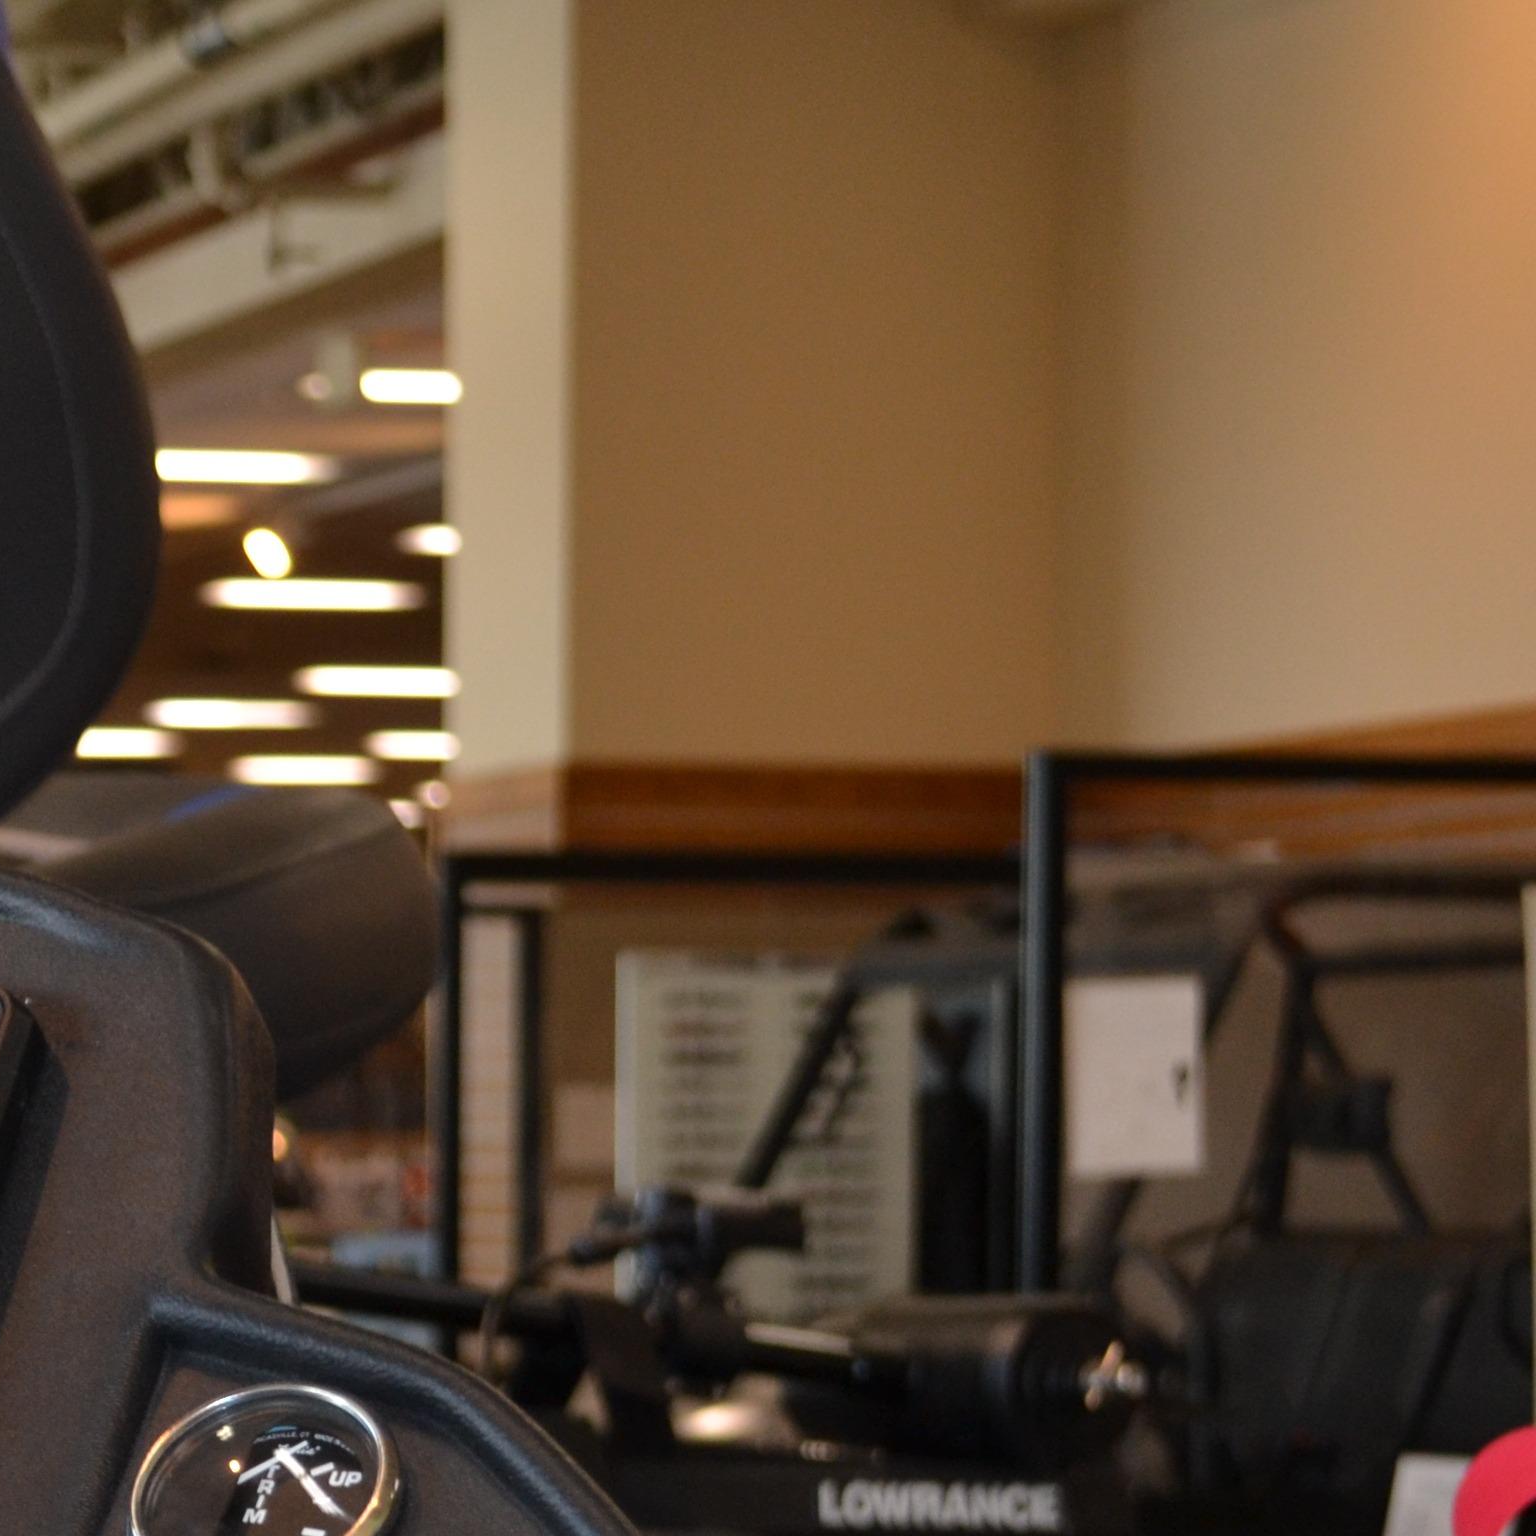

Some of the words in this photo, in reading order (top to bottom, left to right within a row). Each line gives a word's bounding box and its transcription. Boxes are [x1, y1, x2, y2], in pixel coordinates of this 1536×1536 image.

[242, 1465, 279, 1524] TRIM
[328, 1470, 362, 1487] UP
[818, 1480, 1061, 1531] LOWRANCE
